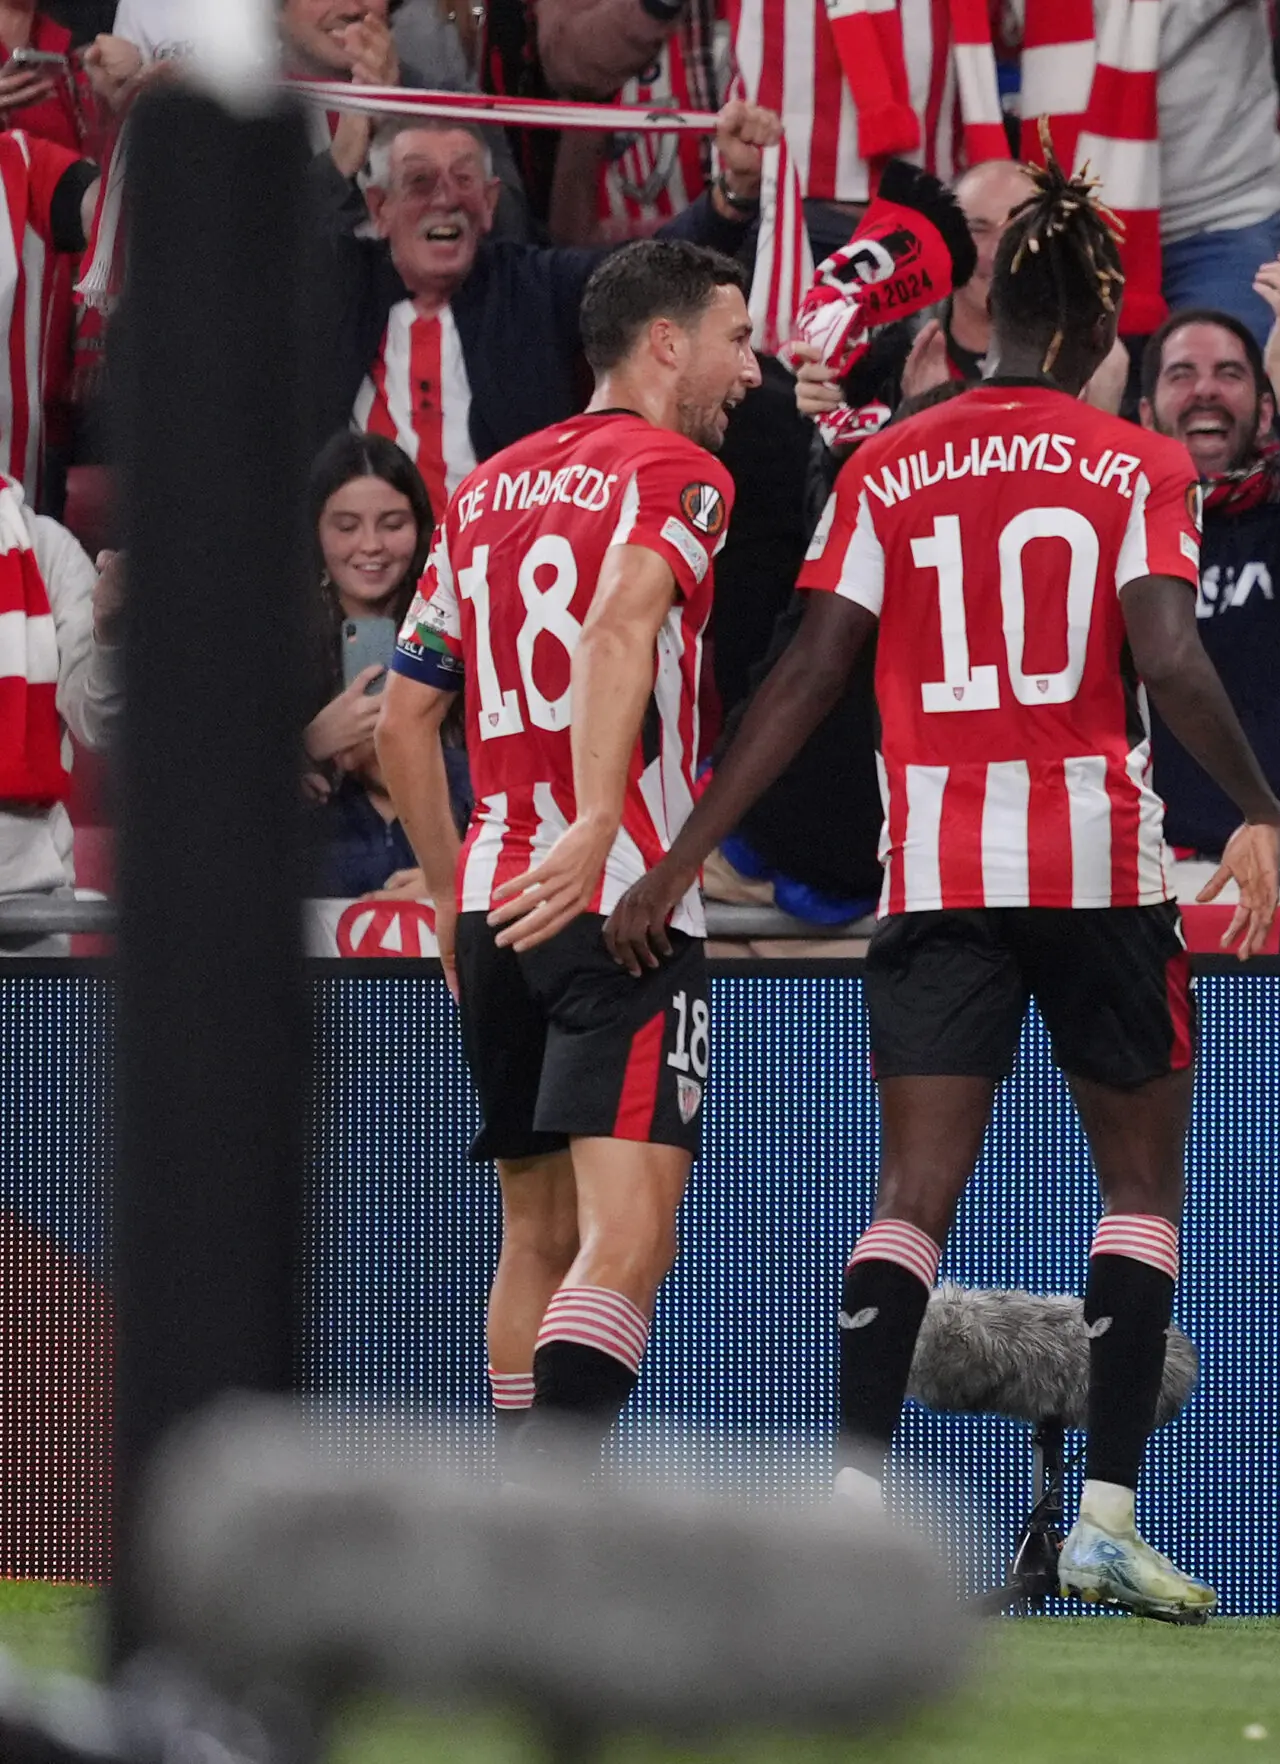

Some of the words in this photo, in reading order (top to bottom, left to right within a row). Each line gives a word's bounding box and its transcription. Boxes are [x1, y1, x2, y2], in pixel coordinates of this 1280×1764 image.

[883, 268, 933, 308] 2024
[457, 479, 489, 533] DE
[491, 463, 618, 512] MARCOS
[863, 432, 1076, 508] WILLIAMS
[1079, 448, 1141, 499] JR.
[457, 533, 584, 740] 18
[909, 506, 1100, 713] 10
[667, 990, 709, 1078] 18
